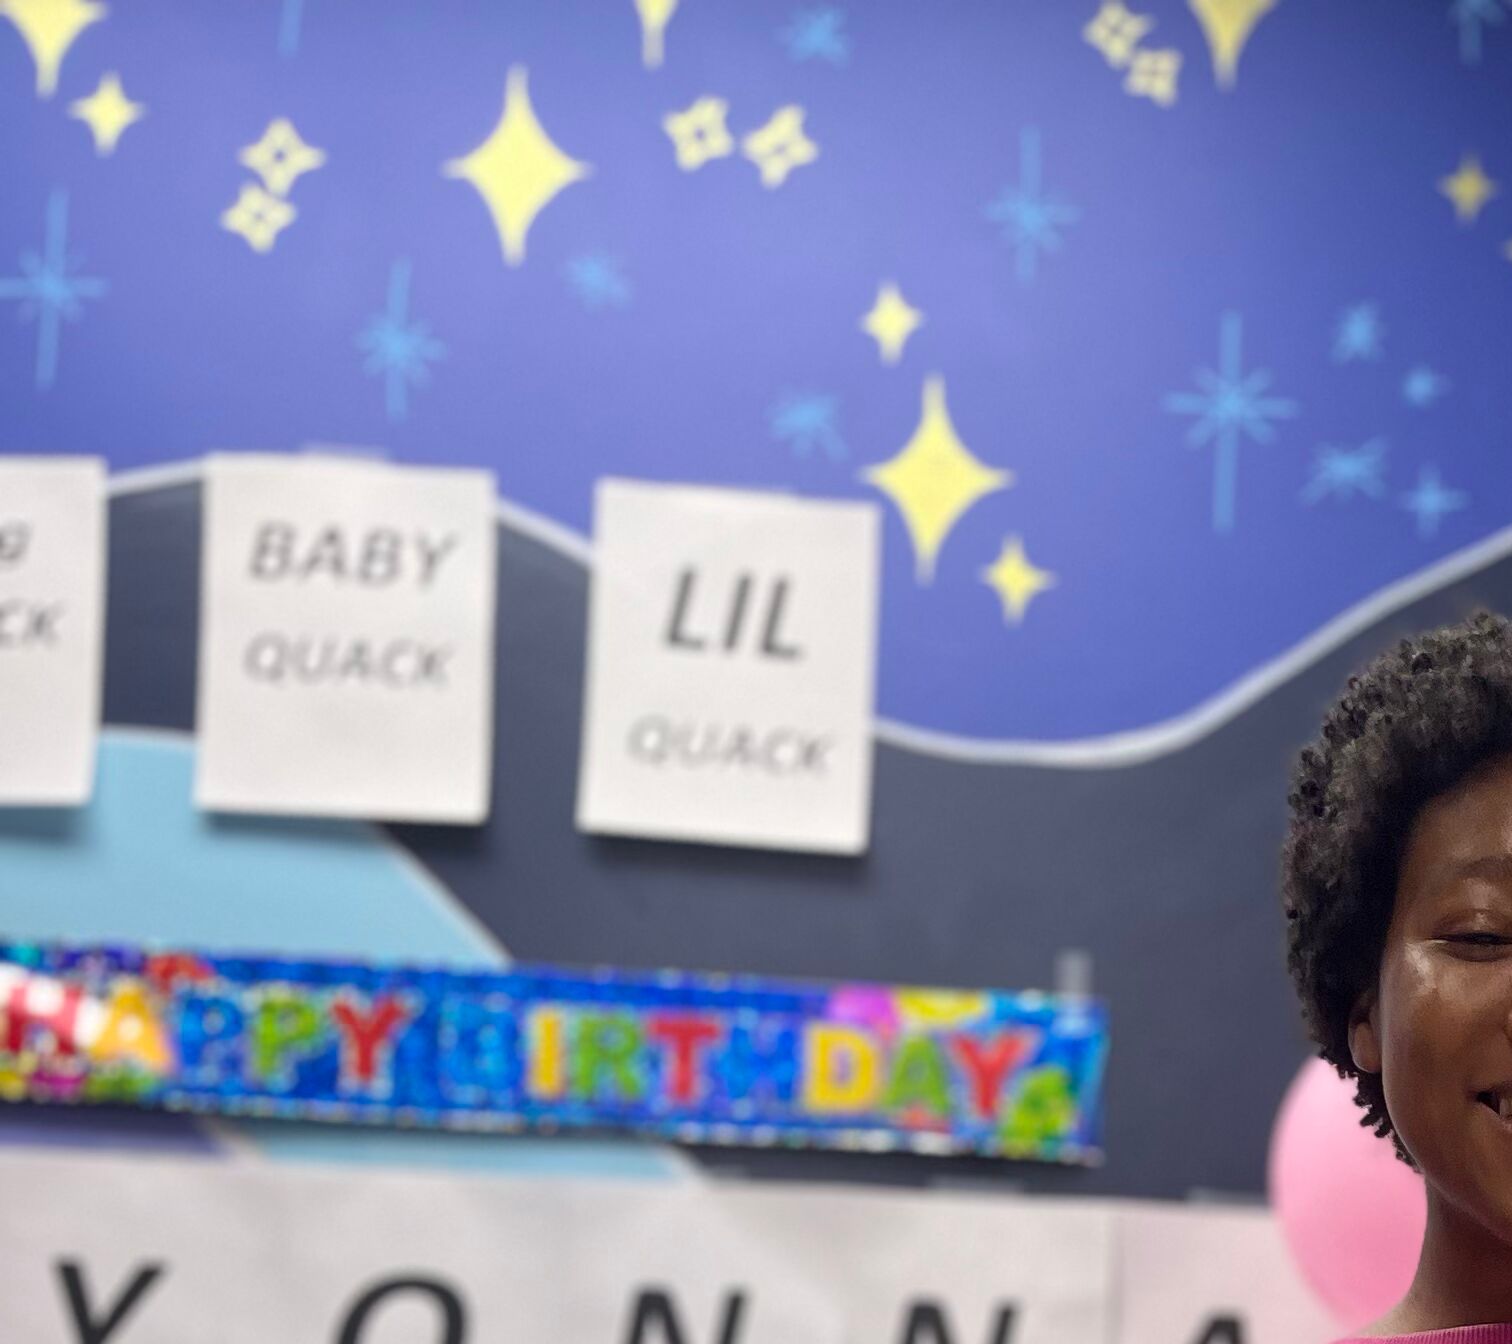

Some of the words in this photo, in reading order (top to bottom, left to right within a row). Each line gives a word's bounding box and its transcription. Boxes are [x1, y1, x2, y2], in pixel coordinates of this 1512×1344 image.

[247, 517, 460, 588] BABY
[662, 563, 807, 663] LIL
[243, 630, 454, 686] QUACK
[626, 712, 832, 777] QUACK
[0, 978, 415, 1088] HAPPY
